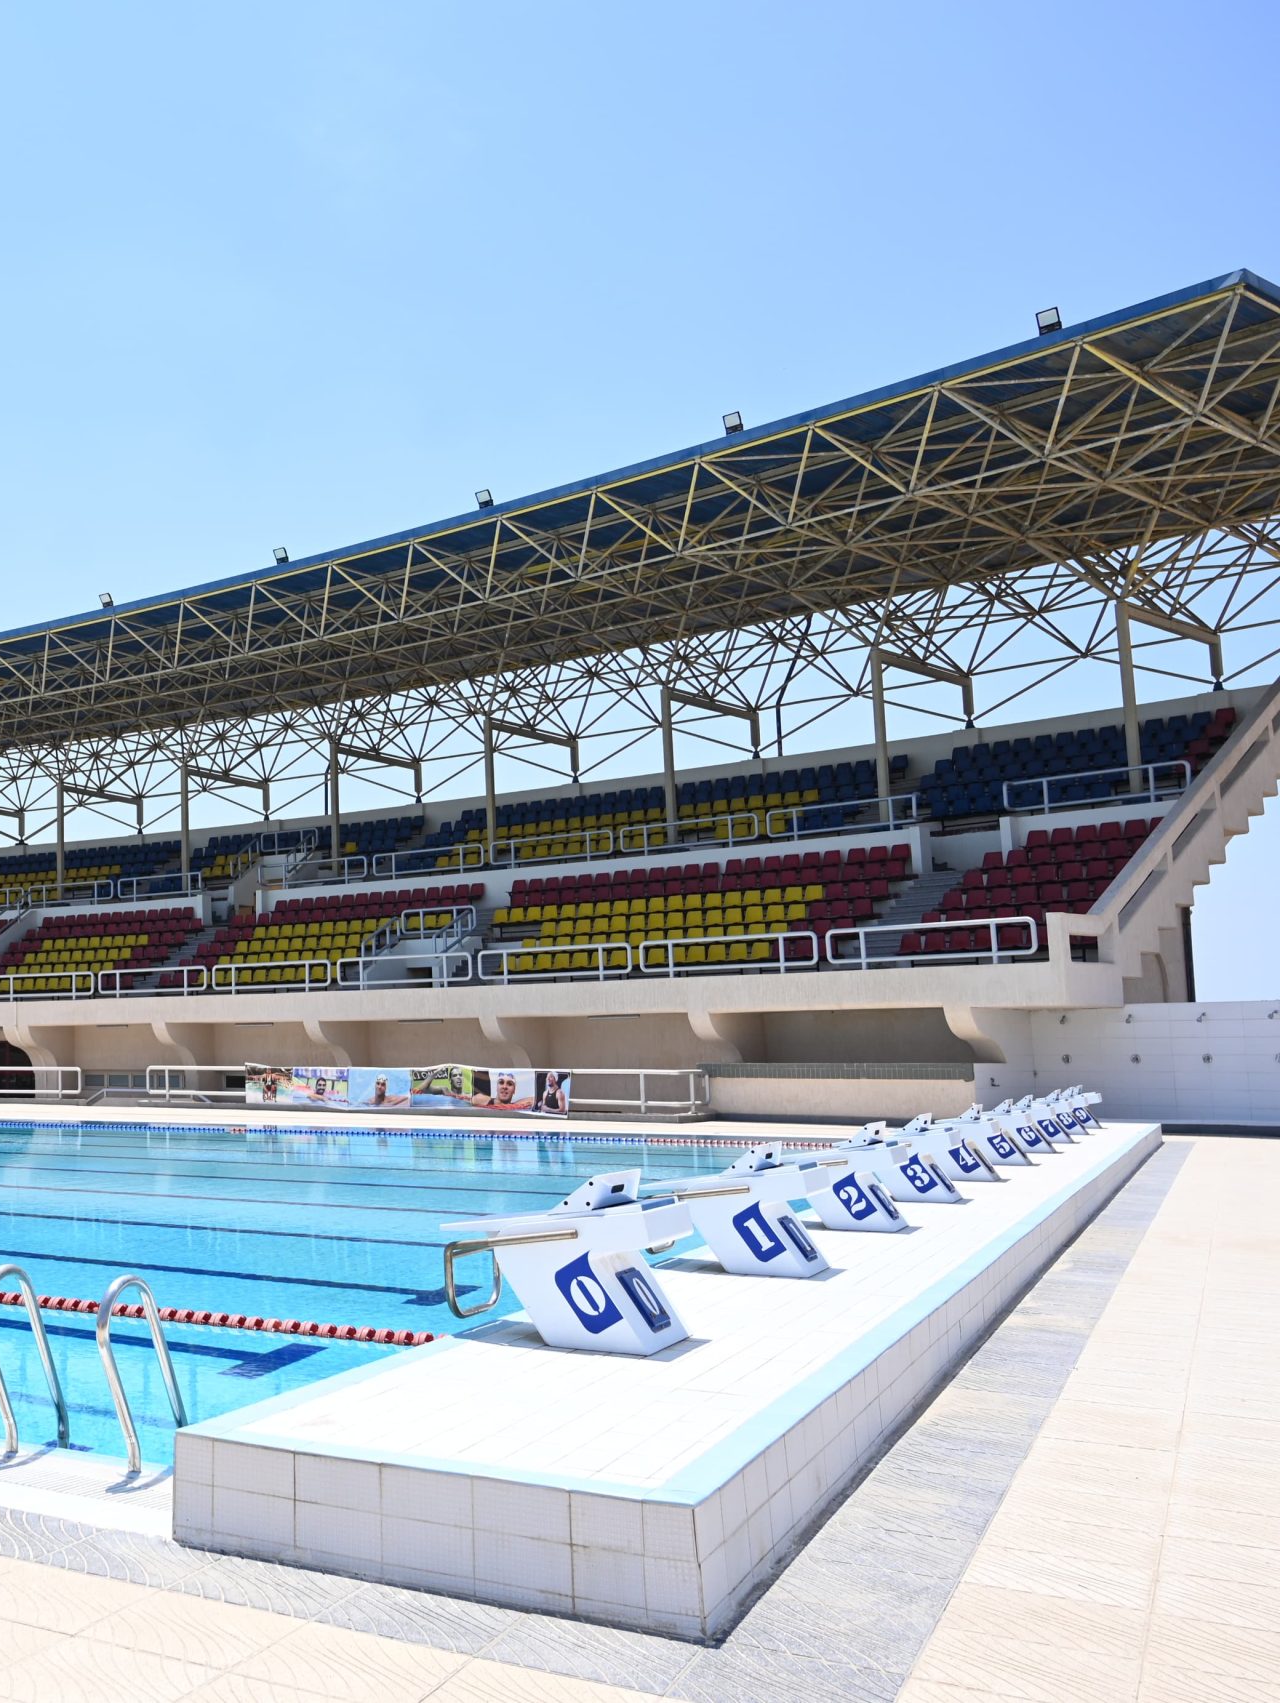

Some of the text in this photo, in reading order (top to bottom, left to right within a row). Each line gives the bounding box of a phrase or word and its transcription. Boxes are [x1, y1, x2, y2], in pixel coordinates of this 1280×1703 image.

[1059, 1112, 1073, 1125] 8
[1075, 1109, 1087, 1121] 9
[1020, 1127, 1036, 1141] 6
[1042, 1120, 1055, 1133] 7
[992, 1135, 1011, 1154] 5
[959, 1146, 976, 1166] 4
[906, 1164, 930, 1187] 3
[839, 1186, 867, 1214] 2
[743, 1217, 775, 1252] 1
[570, 1275, 606, 1316] 0
[632, 1277, 660, 1315] 0
